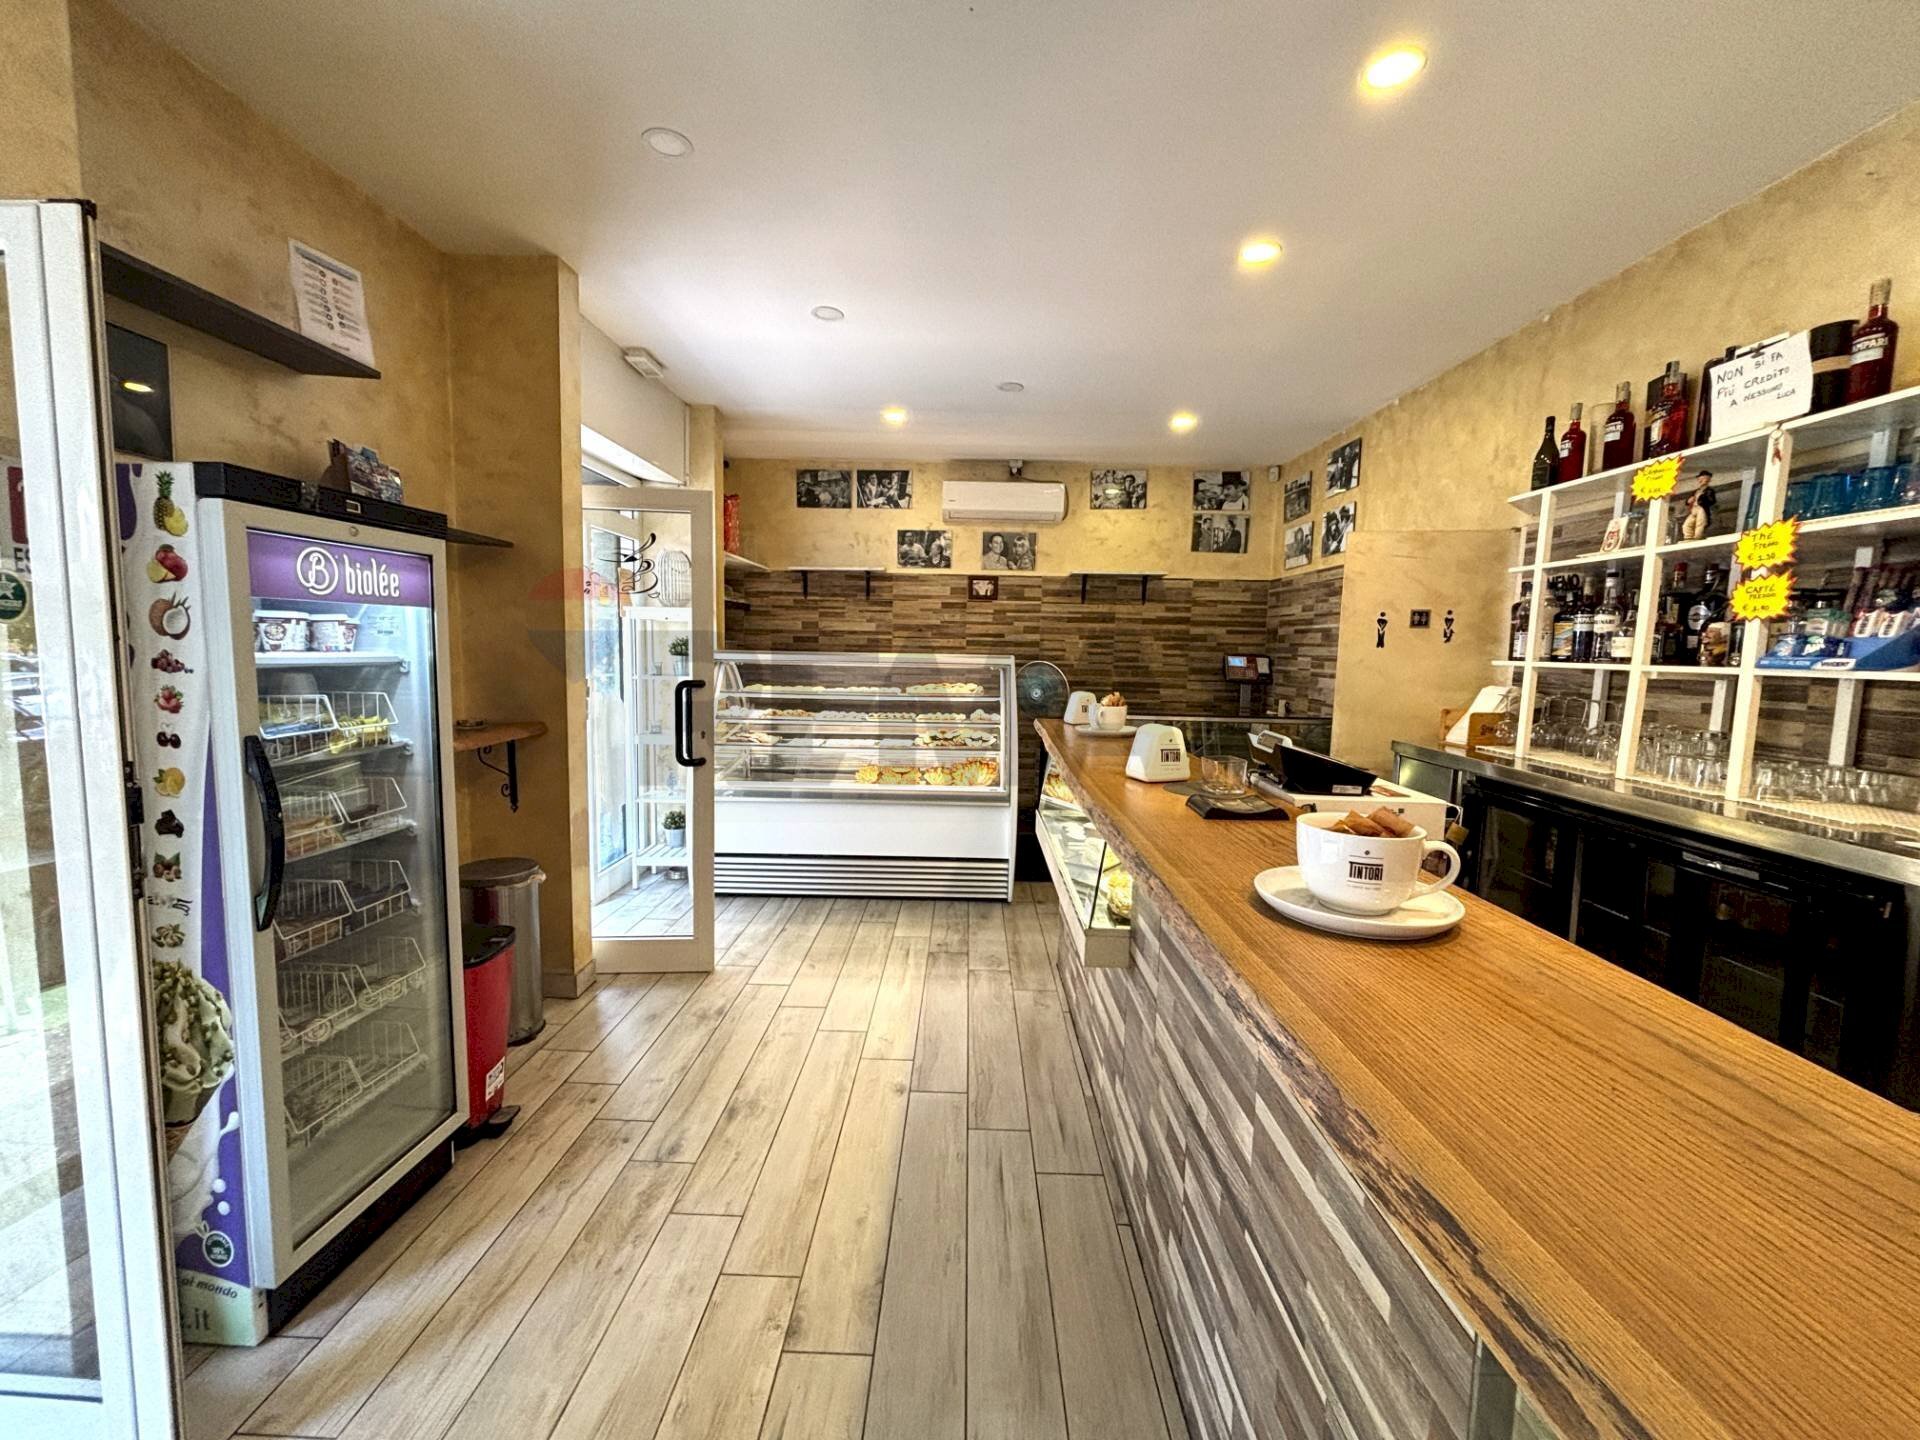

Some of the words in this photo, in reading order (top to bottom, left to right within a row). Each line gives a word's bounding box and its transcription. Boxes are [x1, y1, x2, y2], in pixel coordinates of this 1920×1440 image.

[1716, 366, 1744, 384] NON
[1770, 352, 1783, 362] FA
[1729, 399, 1738, 407] A
[343, 554, 400, 597] biolée
[1348, 861, 1384, 881] TINTORI
[196, 1280, 238, 1299] mondo
